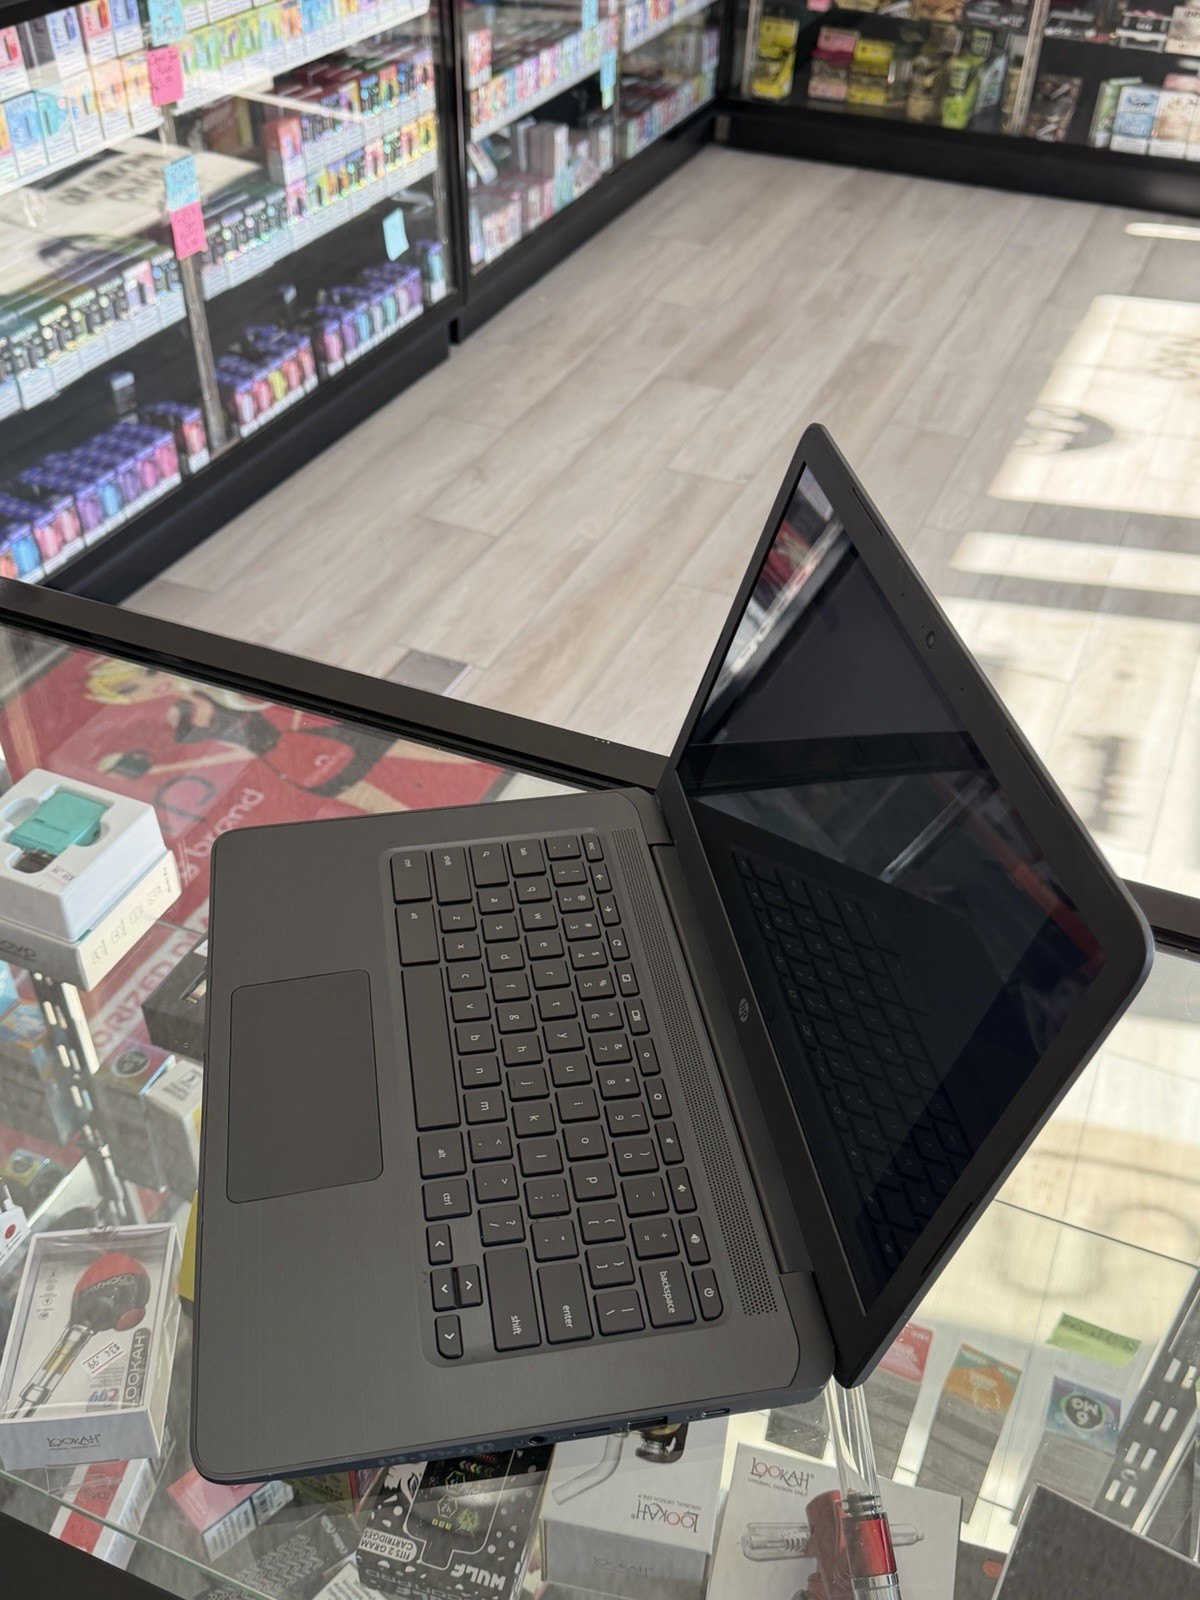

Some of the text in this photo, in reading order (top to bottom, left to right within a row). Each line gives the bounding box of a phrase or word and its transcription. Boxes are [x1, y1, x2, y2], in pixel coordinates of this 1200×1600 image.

[437, 1148, 447, 1159] alt
[442, 1192, 453, 1206] ctrl
[659, 1270, 676, 1314] backspace
[510, 1315, 522, 1335] shift
[562, 1304, 573, 1328] enter
[750, 1457, 810, 1491] LOOKAH
[636, 1500, 699, 1533] LOOKAH
[360, 1538, 411, 1560] FITS 2 GRAM
[363, 1530, 414, 1551] CARTRIDGES
[450, 1563, 507, 1591] WULF
